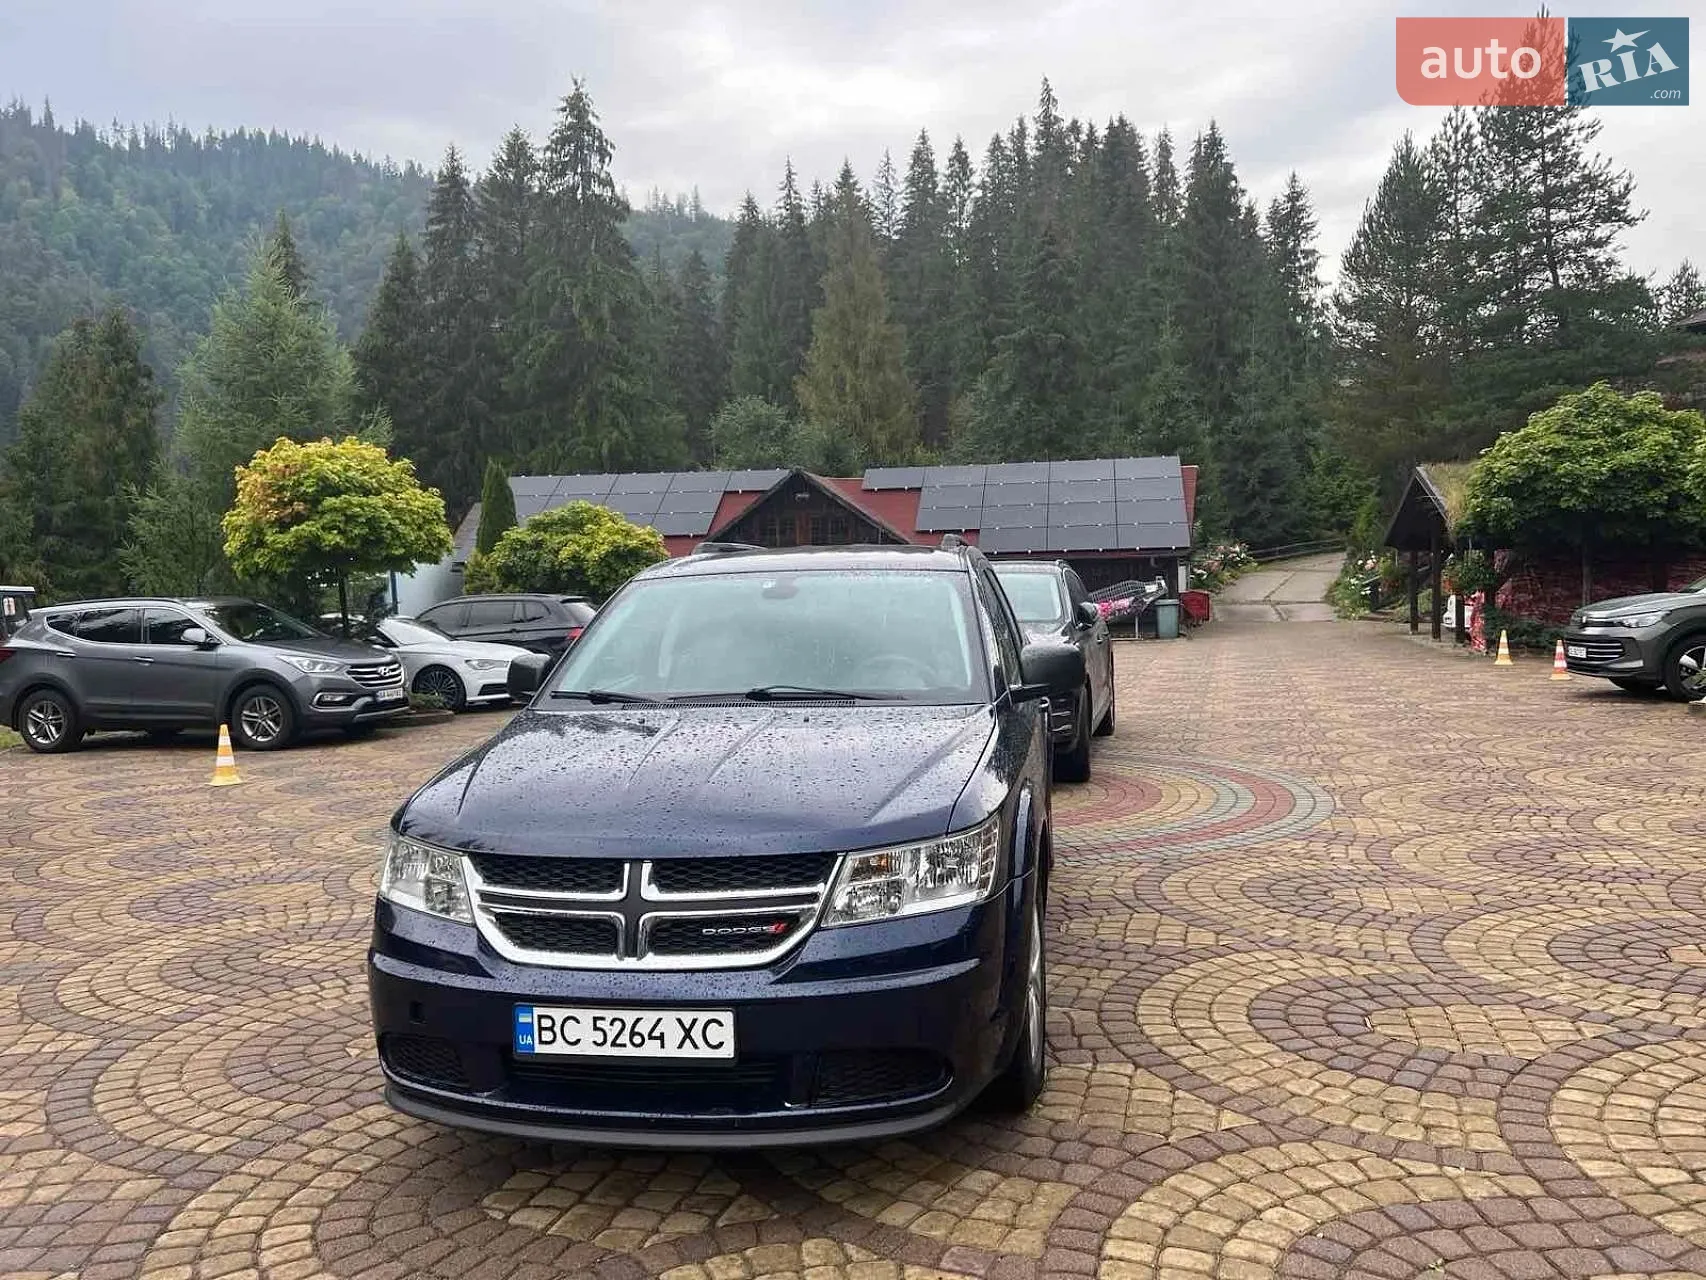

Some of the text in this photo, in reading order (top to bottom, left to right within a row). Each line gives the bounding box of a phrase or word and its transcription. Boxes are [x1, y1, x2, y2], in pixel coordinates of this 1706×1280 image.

[519, 1034, 533, 1045] UA
[536, 1014, 725, 1050] BC 5264 XC
